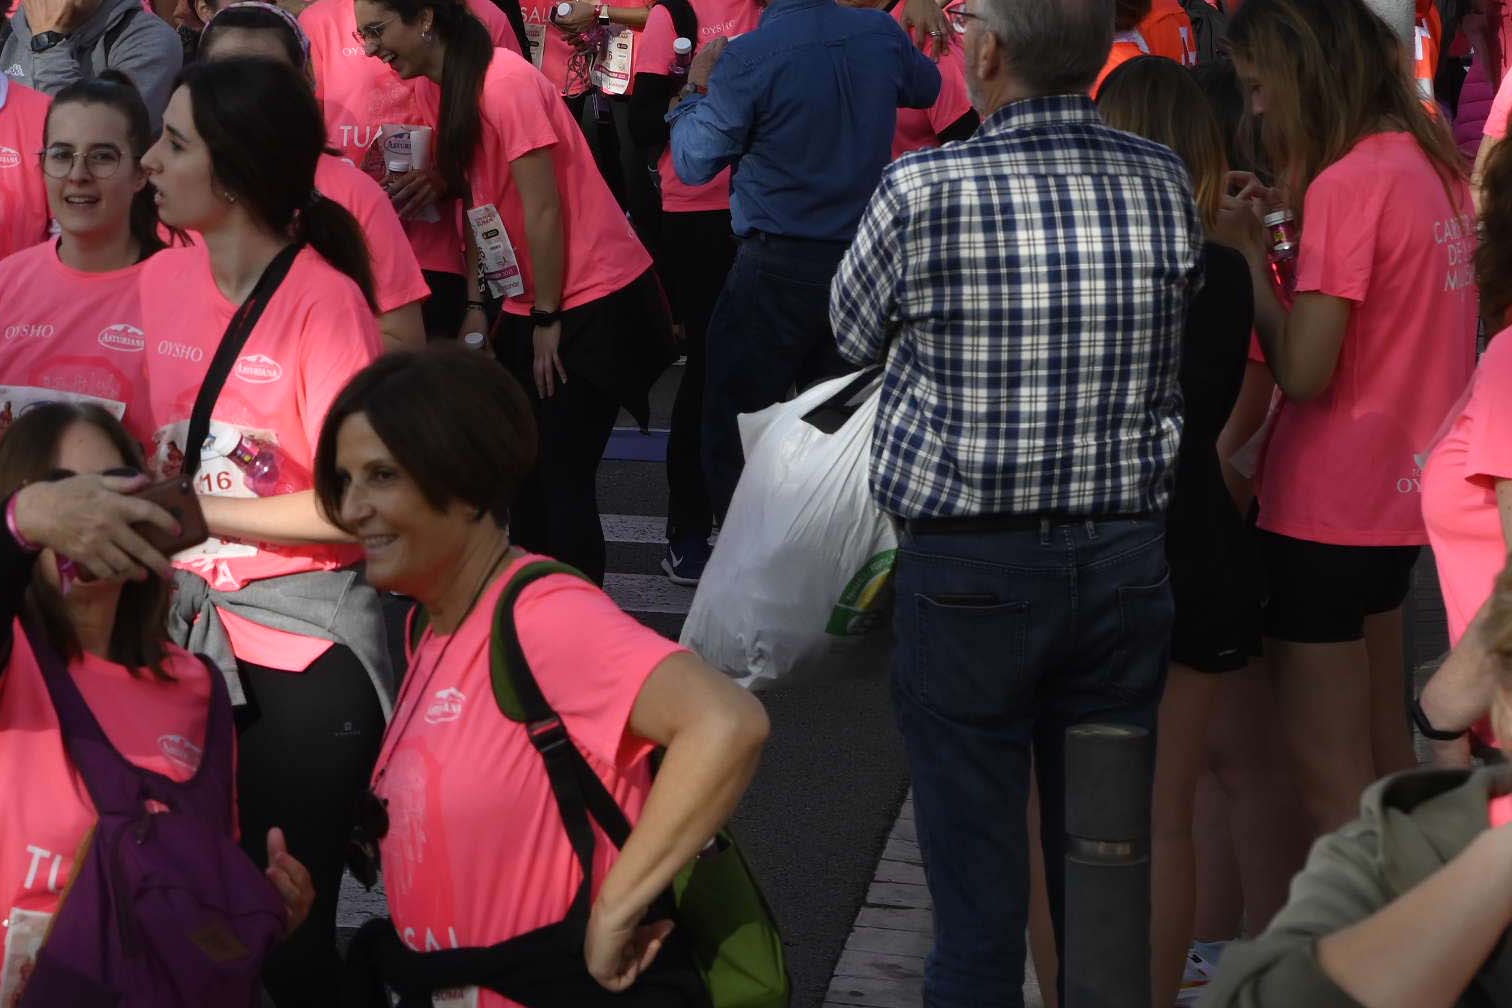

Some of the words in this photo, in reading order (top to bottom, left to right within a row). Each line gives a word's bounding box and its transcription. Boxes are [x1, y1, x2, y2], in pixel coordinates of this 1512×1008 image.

[339, 125, 371, 149] TU
[4, 323, 56, 340] OYSHO
[158, 339, 205, 363] OYSHO
[200, 471, 233, 494] 16
[1396, 478, 1423, 494] OY
